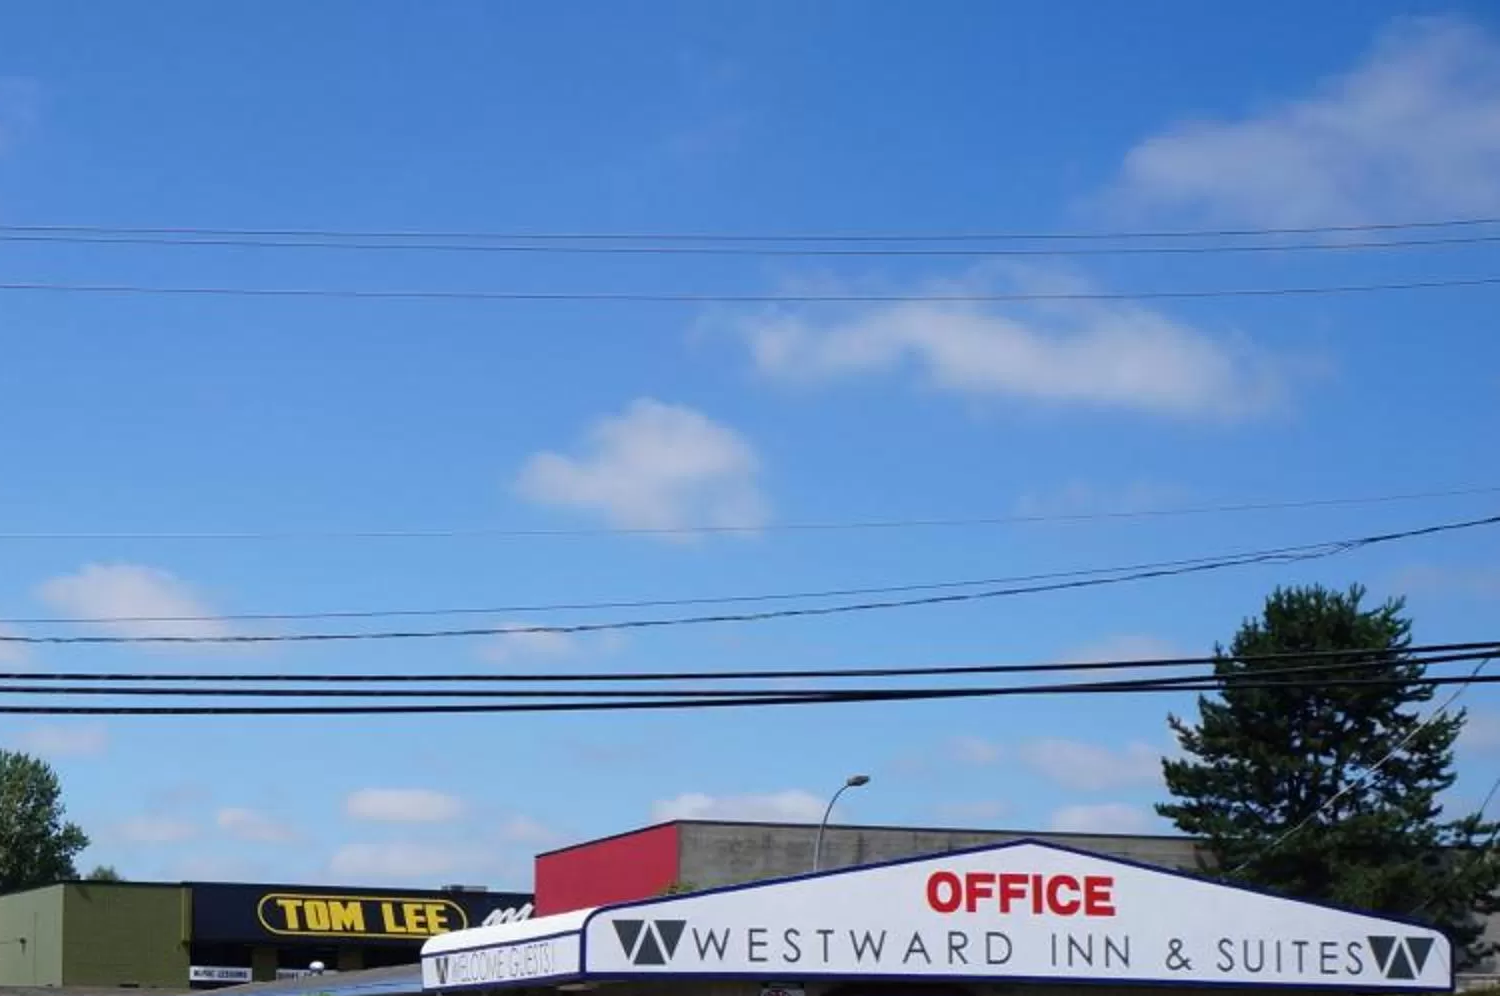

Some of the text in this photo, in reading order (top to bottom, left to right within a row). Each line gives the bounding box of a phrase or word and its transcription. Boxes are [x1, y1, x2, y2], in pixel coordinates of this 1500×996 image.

[275, 899, 366, 931] TOM
[381, 902, 449, 933] LEE
[926, 871, 1115, 916] OFFICE
[692, 927, 1364, 975] WESTWARD INN & SUITES
